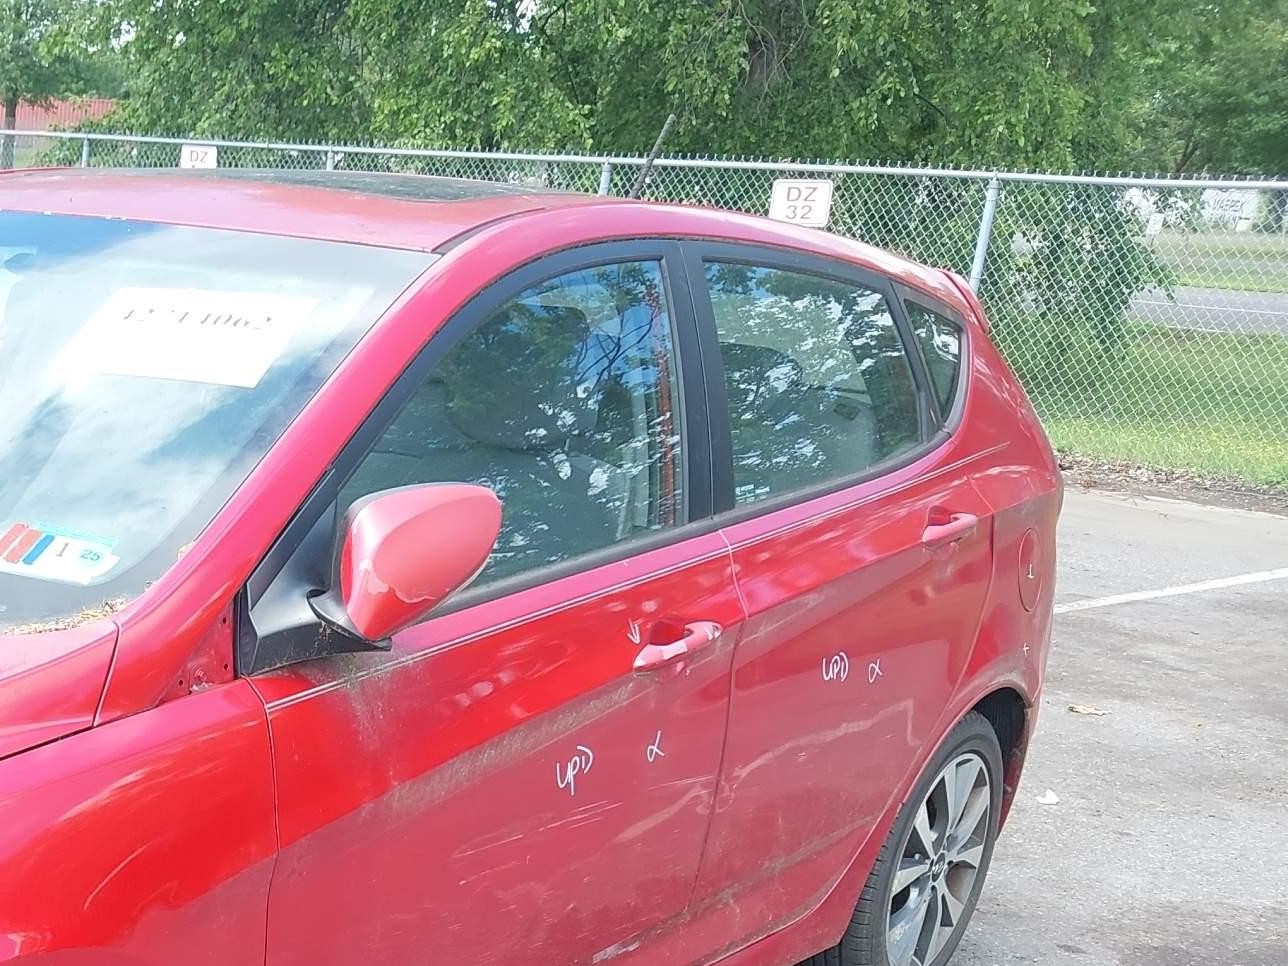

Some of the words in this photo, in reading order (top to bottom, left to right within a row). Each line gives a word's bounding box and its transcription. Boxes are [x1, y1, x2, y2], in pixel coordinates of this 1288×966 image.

[190, 151, 209, 163] DZ
[786, 186, 818, 202] DZ
[785, 205, 813, 220] 32
[80, 549, 101, 562] 25
